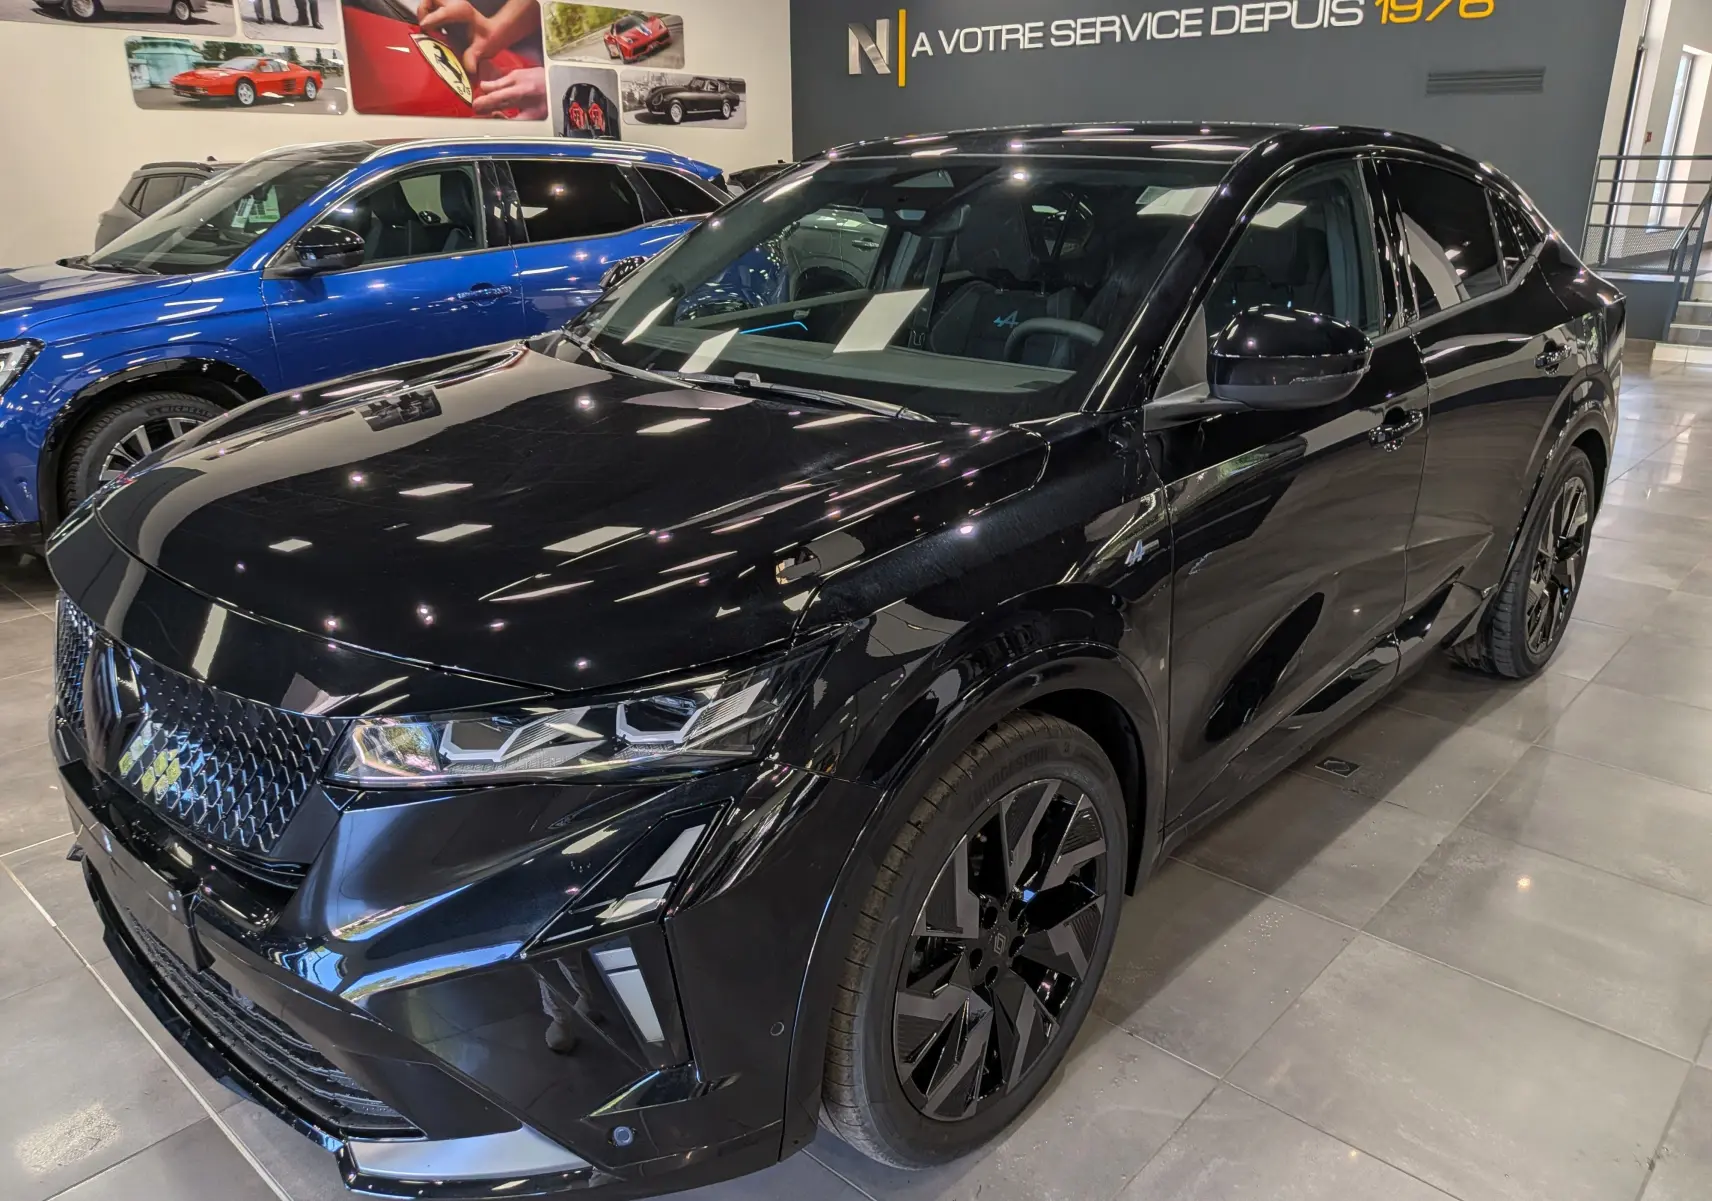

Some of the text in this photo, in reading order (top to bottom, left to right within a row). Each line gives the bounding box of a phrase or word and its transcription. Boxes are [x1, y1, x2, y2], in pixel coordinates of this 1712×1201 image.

[848, 18, 891, 75] N
[911, 31, 934, 58] A
[937, 21, 1045, 55] VOTRE
[1050, 7, 1204, 47] SERVICE
[1210, 0, 1365, 36] DEPUIS
